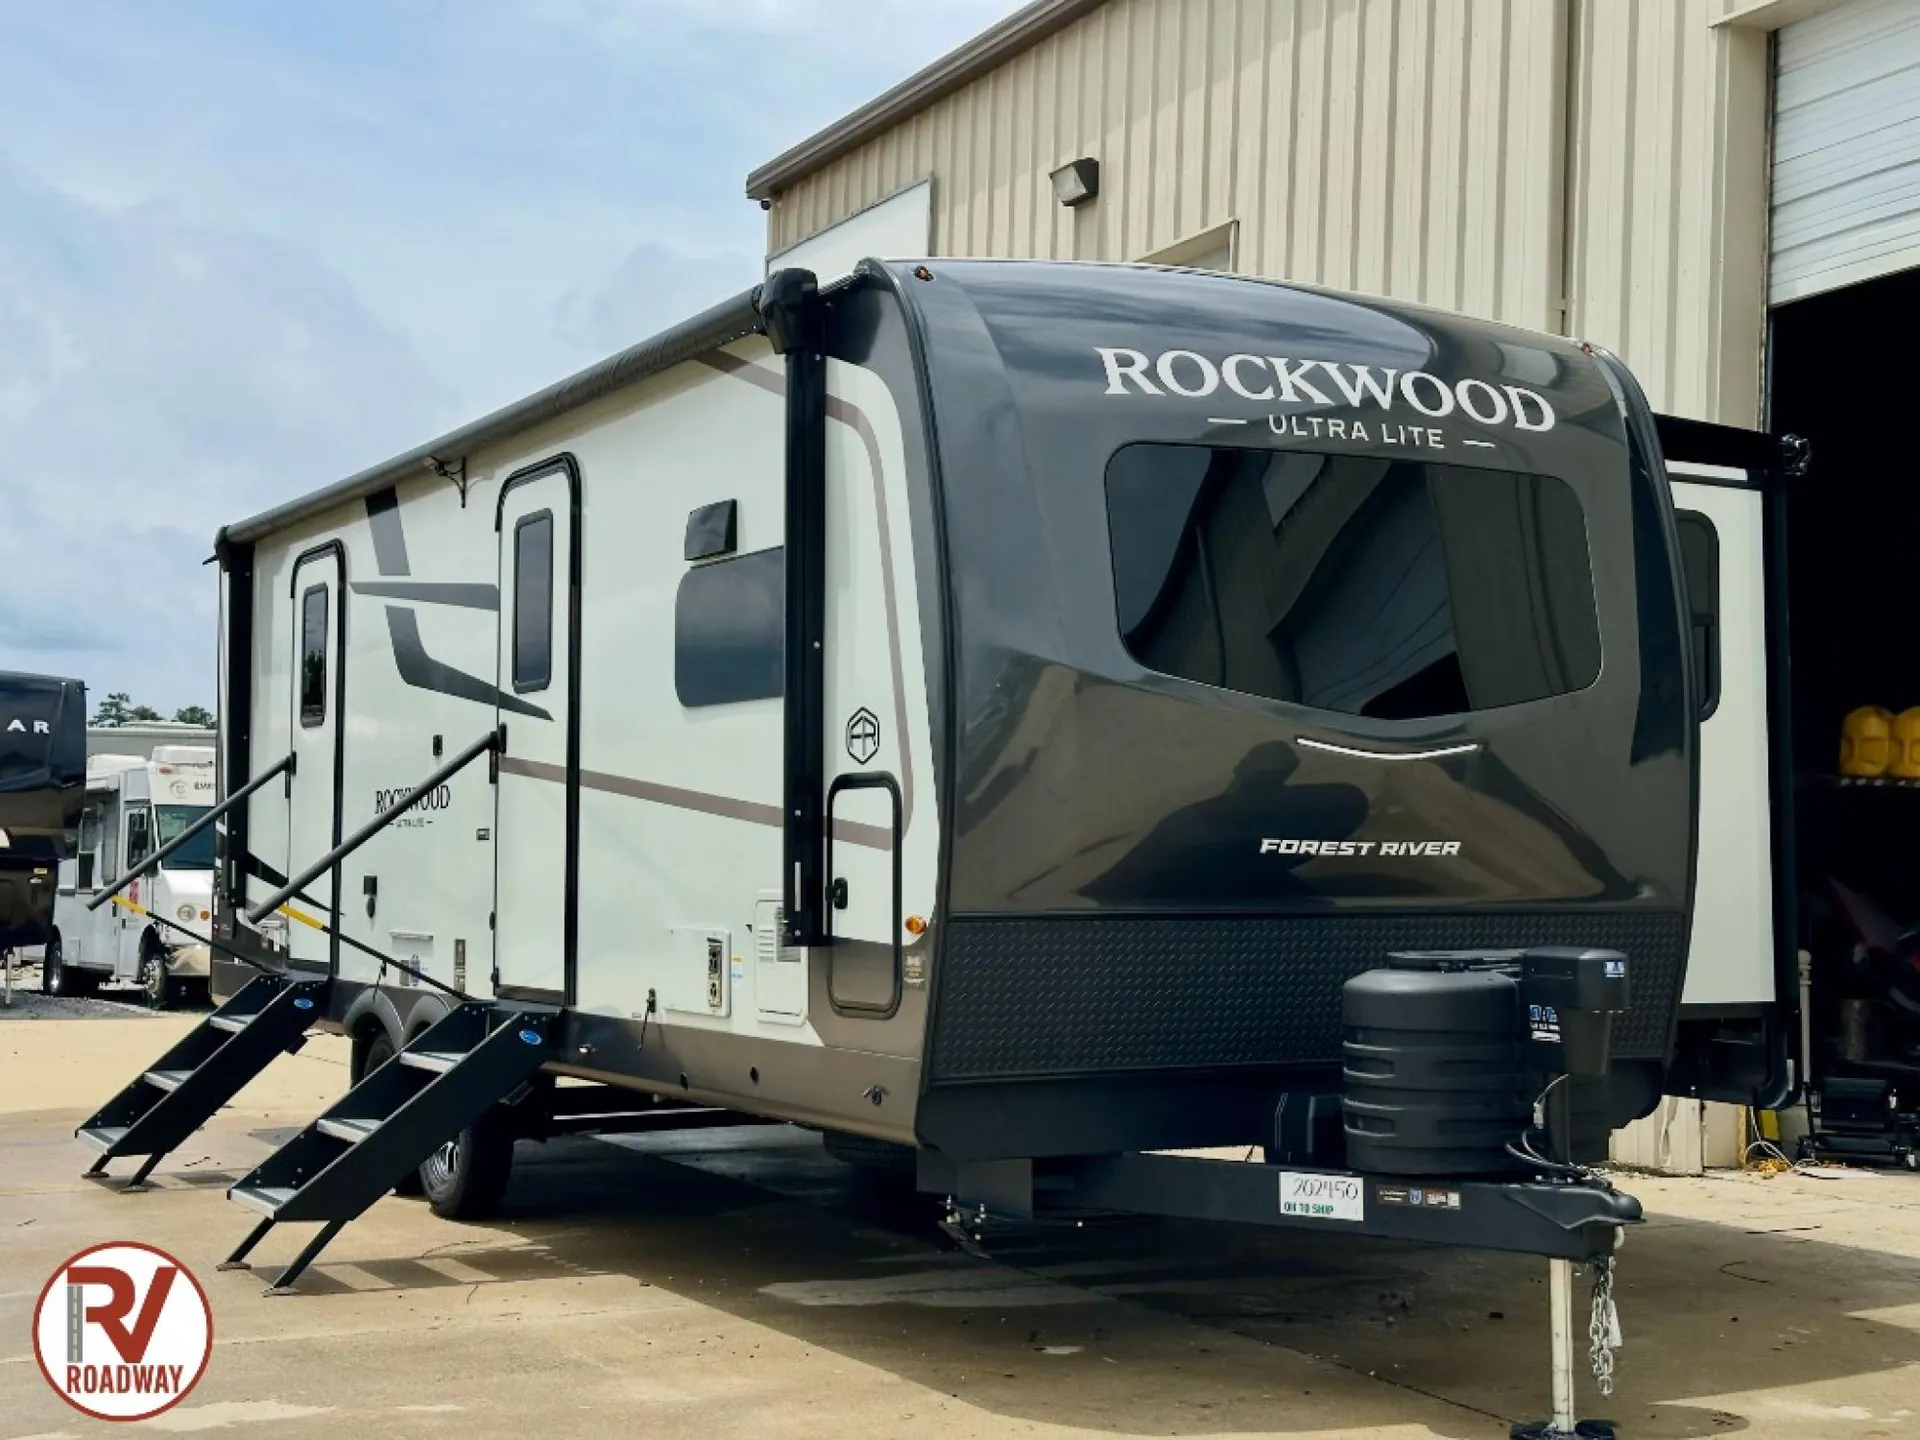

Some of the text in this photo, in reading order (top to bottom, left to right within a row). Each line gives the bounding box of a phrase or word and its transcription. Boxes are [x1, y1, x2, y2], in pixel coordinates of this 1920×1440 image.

[1093, 346, 1556, 432] ROCKWOOD
[1268, 414, 1445, 449] ULTRA LITE
[1259, 838, 1462, 856] FOREST RIVER
